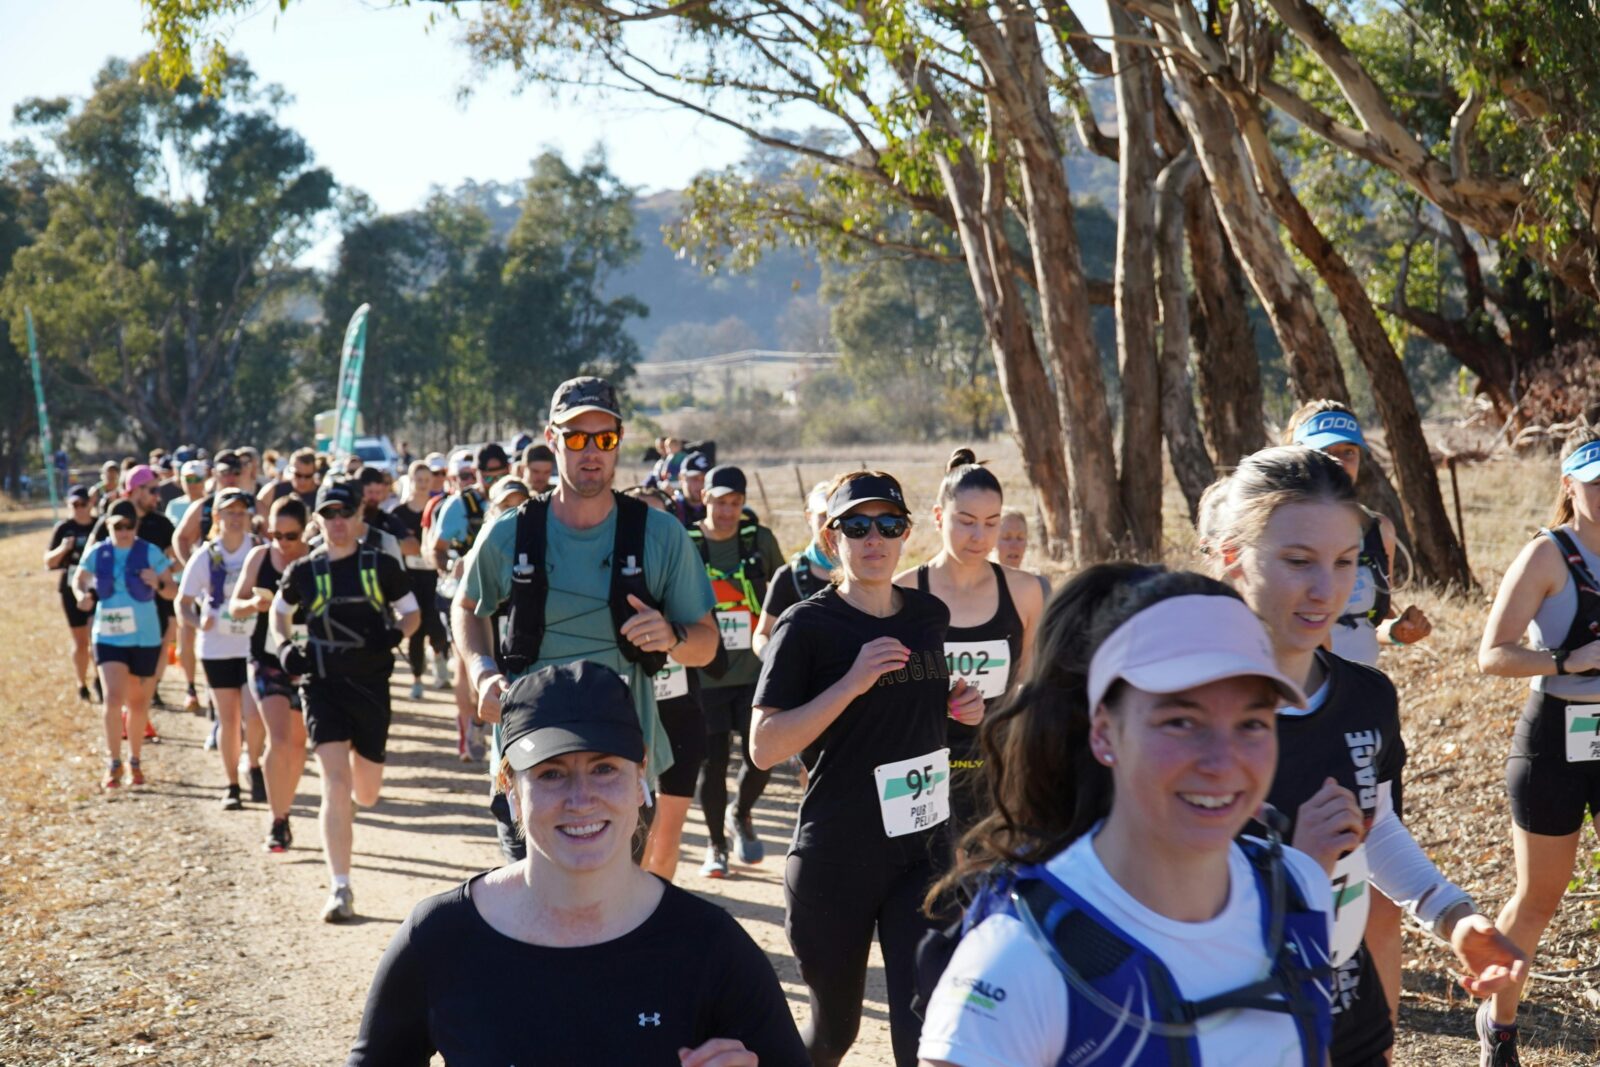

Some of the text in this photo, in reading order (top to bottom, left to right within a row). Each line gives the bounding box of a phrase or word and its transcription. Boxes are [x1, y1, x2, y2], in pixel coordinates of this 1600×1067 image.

[947, 651, 990, 676] 102
[906, 764, 936, 801] 95
[1344, 729, 1377, 810] RACE
